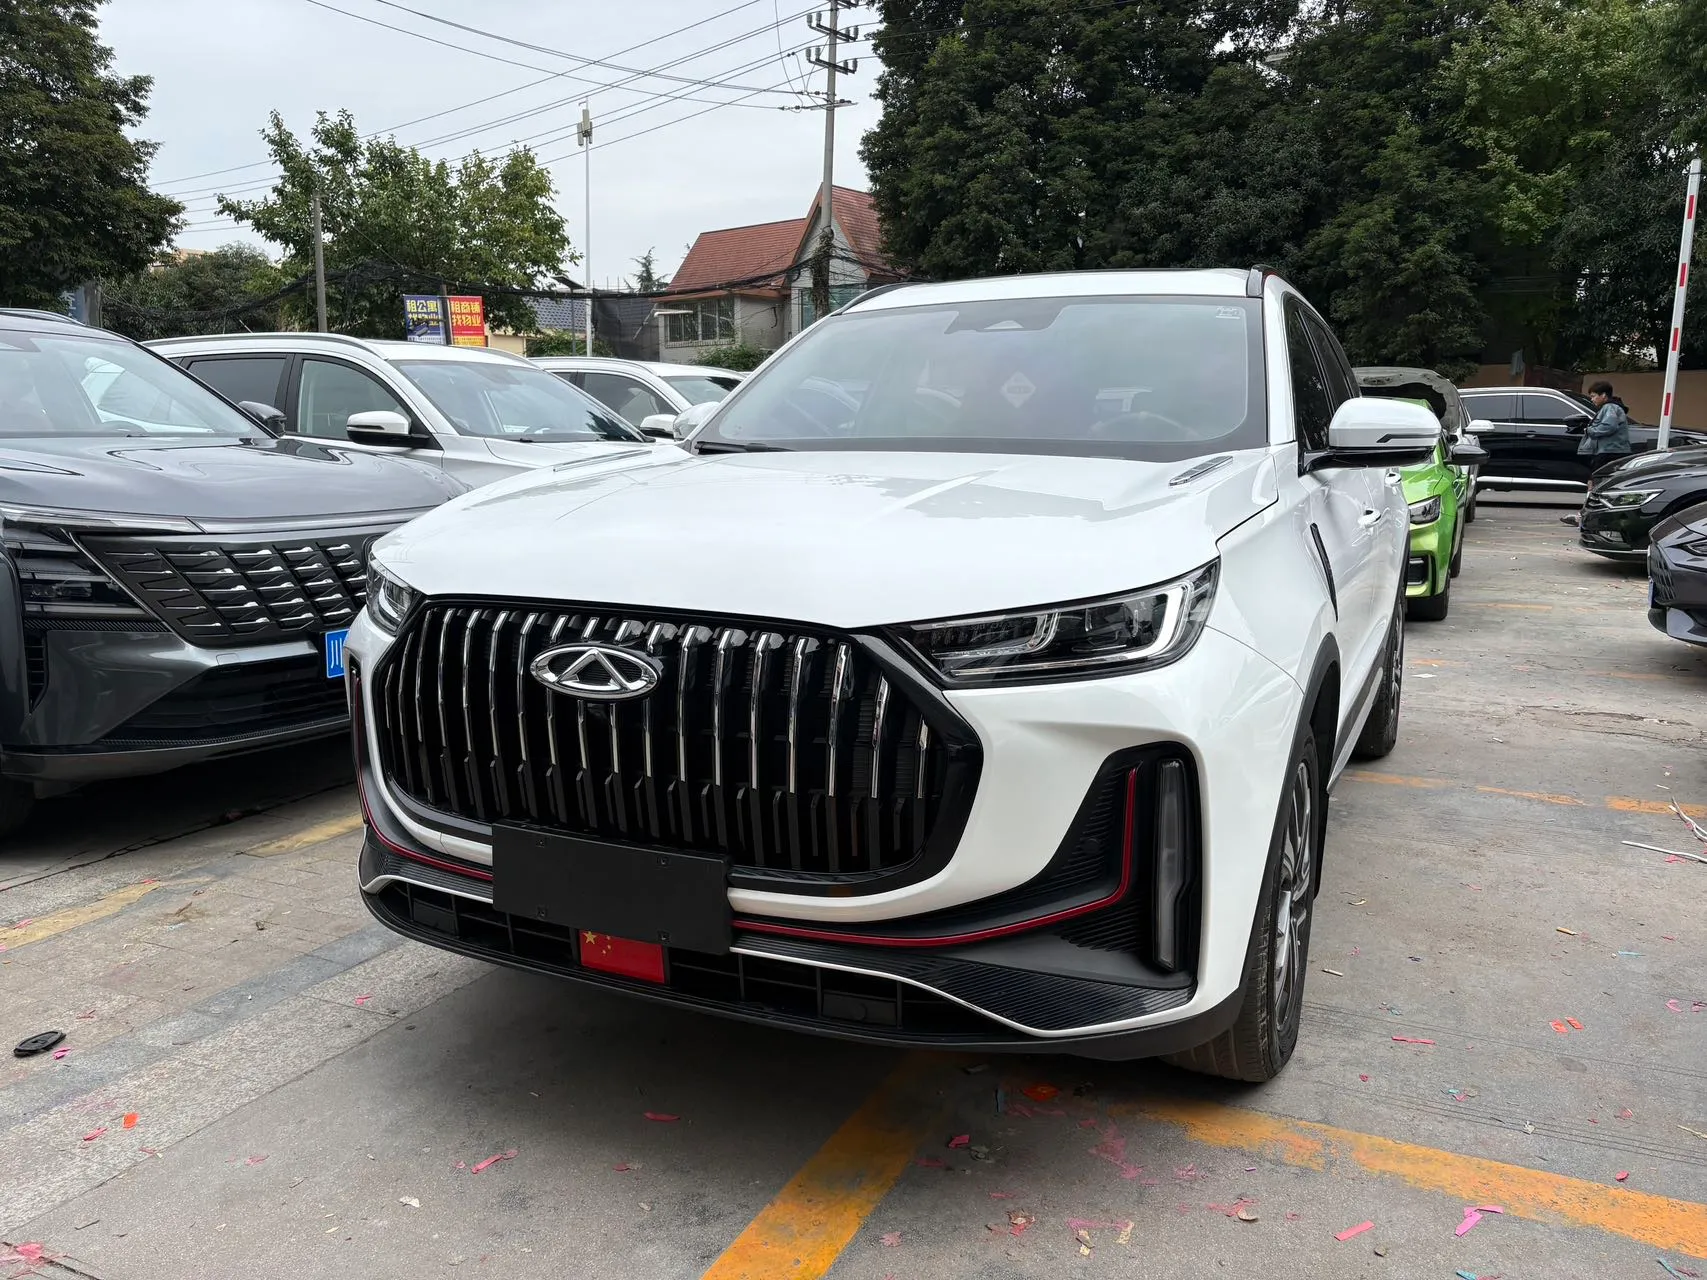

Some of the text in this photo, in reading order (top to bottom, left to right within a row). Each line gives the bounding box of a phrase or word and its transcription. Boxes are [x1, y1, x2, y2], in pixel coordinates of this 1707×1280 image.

[406, 300, 438, 313] 租公寓
[450, 301, 481, 313] 租商铺
[452, 314, 482, 327] 找物业
[330, 637, 343, 669] 川
